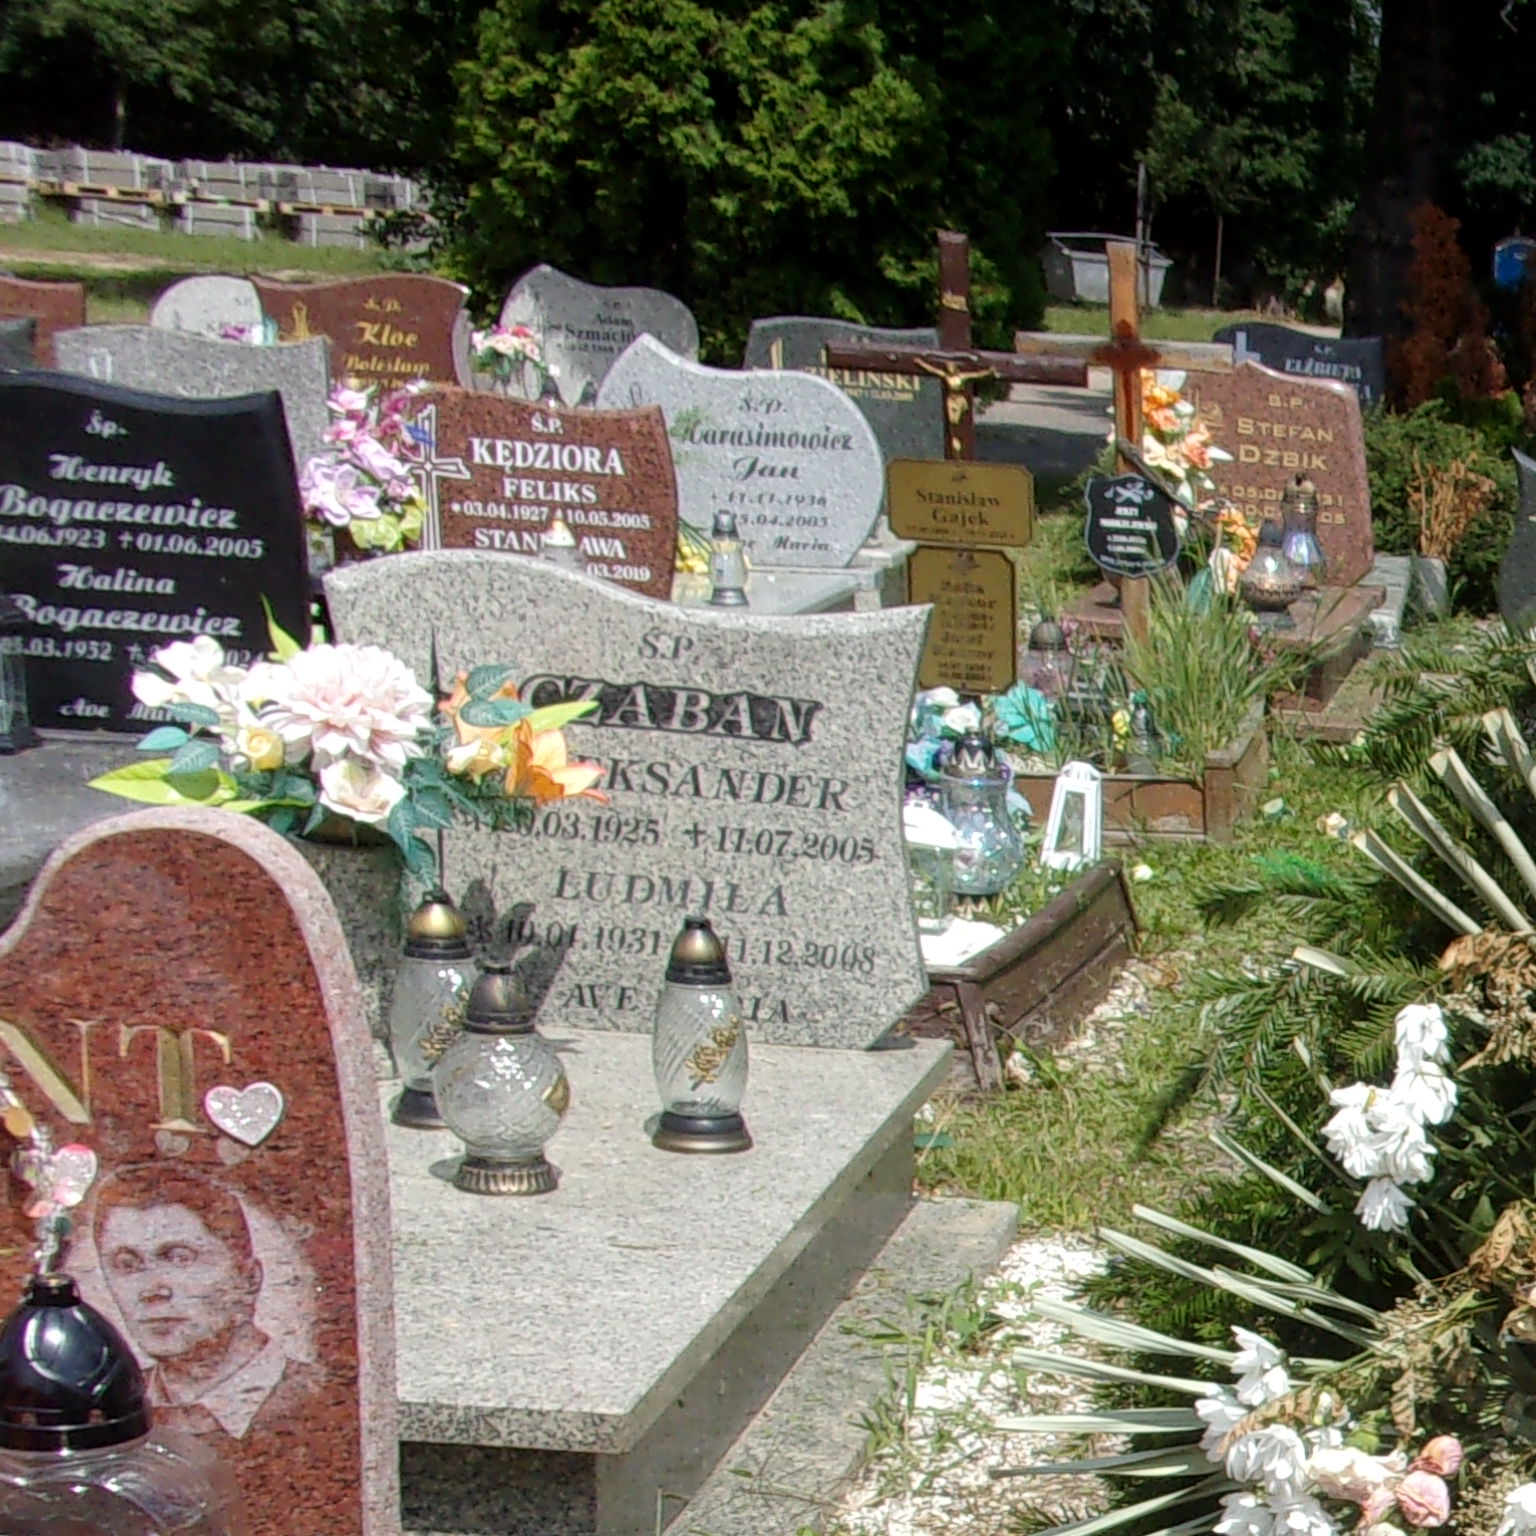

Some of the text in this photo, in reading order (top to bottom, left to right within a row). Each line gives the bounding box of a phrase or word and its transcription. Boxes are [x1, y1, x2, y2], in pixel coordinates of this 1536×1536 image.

[1237, 418, 1334, 443] STEFAN
[471, 437, 625, 476] KĘDZIORA
[732, 457, 800, 482] Jan
[1239, 444, 1328, 471] DZBIK
[50, 454, 175, 491] Henryk
[503, 478, 597, 504] FELIKS
[0, 484, 239, 529] Bogaczewicz
[136, 532, 264, 559] 01.06.2005
[475, 528, 626, 560] STANAWA
[57, 564, 176, 594] Halina
[59, 698, 182, 721] Ave Mar
[519, 674, 823, 745] CZABAN
[556, 867, 790, 917] LUDMIŁA
[562, 984, 637, 1012] AVE
